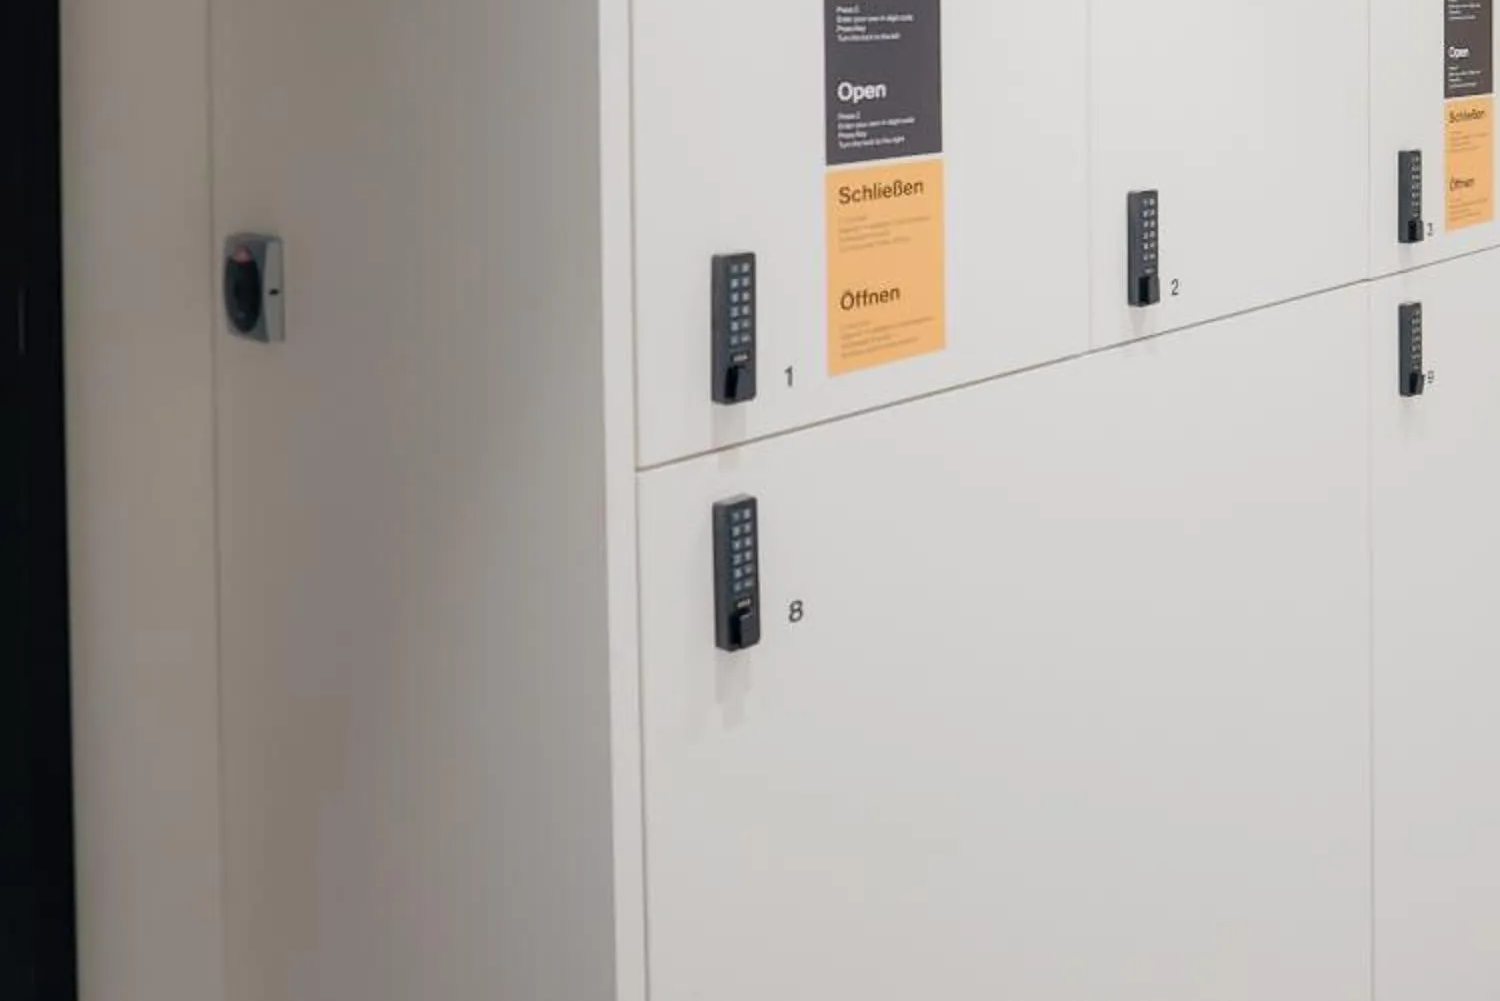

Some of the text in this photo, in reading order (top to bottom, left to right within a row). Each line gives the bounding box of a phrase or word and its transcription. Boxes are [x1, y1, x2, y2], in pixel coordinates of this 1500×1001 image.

[837, 82, 887, 104] Open
[838, 179, 924, 205] Schließen
[1171, 278, 1179, 296] 2
[784, 365, 793, 387] 1
[788, 599, 803, 623] 8
